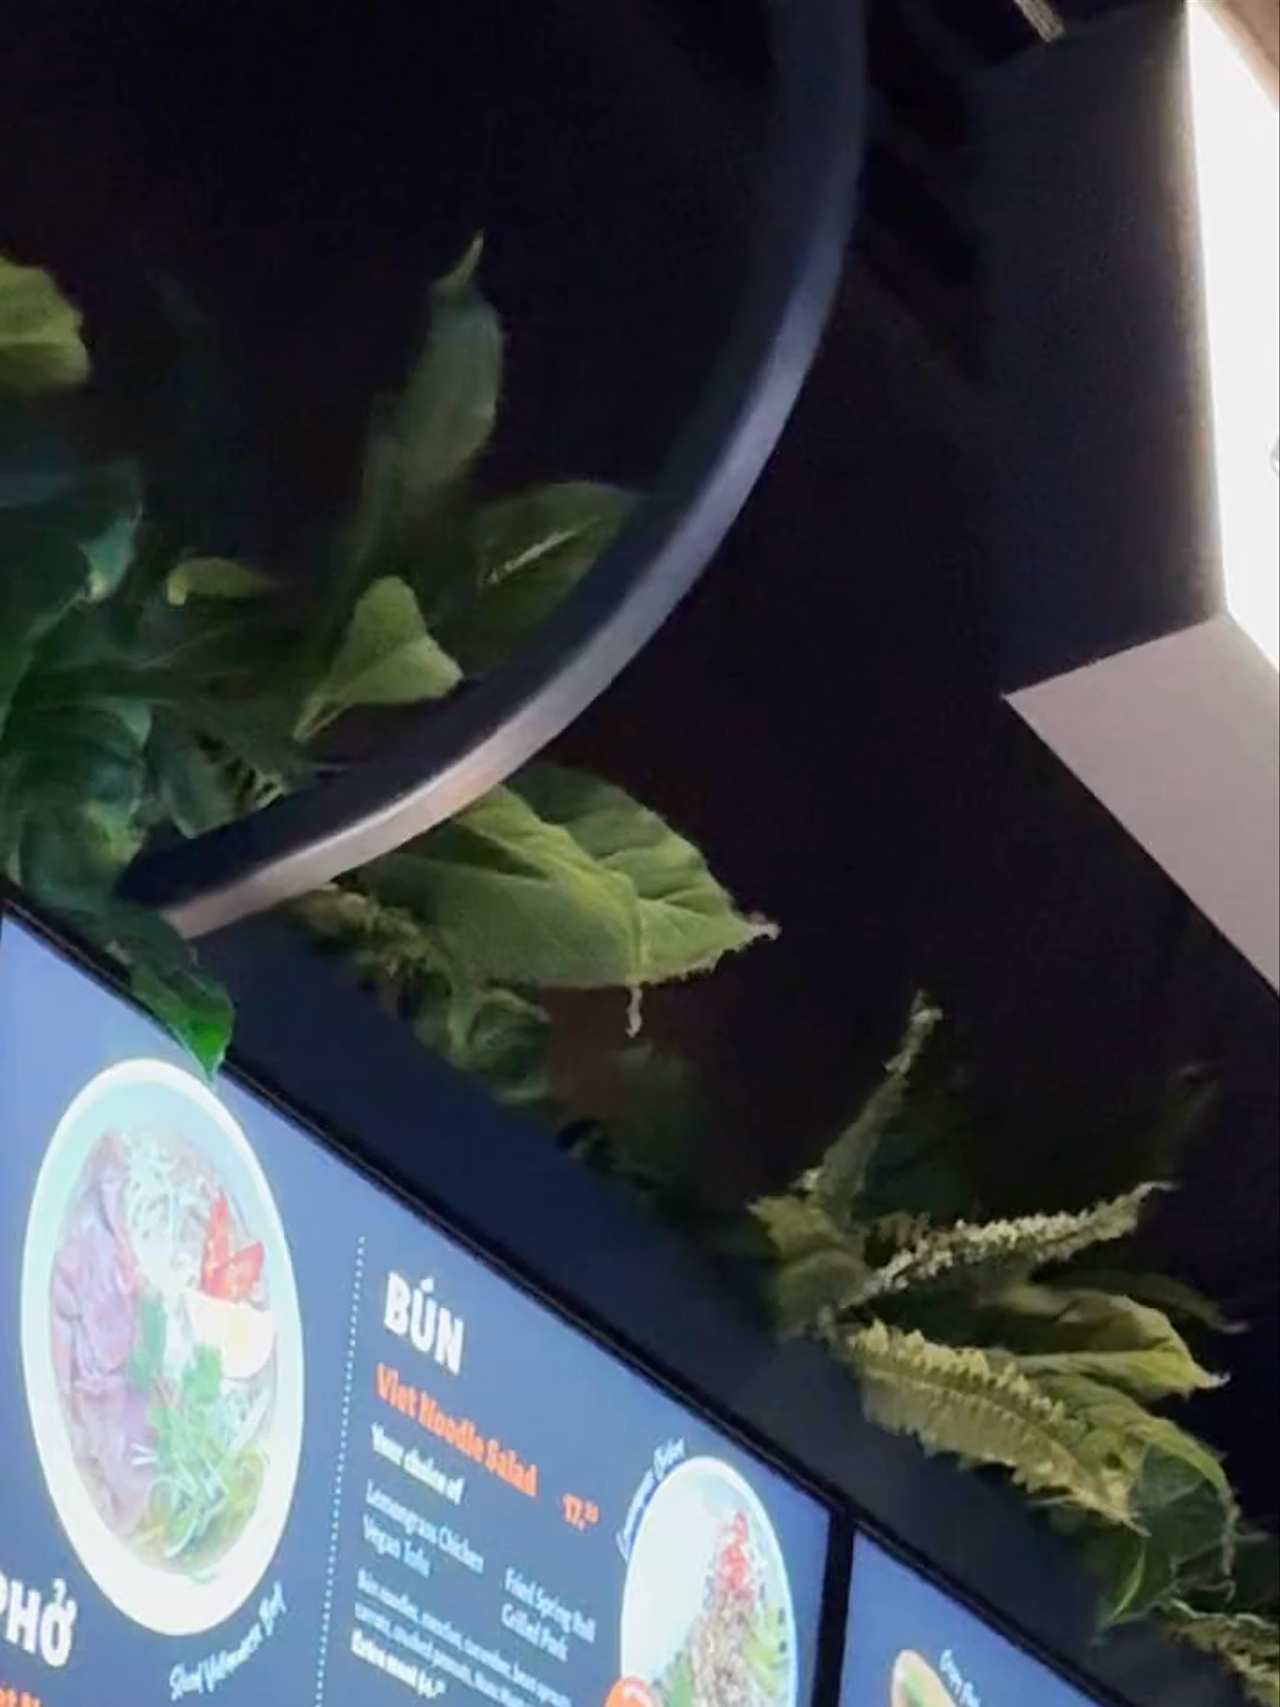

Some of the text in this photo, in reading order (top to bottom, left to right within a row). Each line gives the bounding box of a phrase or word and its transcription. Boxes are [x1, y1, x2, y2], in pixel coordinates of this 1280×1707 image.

[384, 1272, 463, 1372] BÚN
[371, 1424, 464, 1504] Your choice of
[376, 1363, 537, 1495] Viet Noodle Salad
